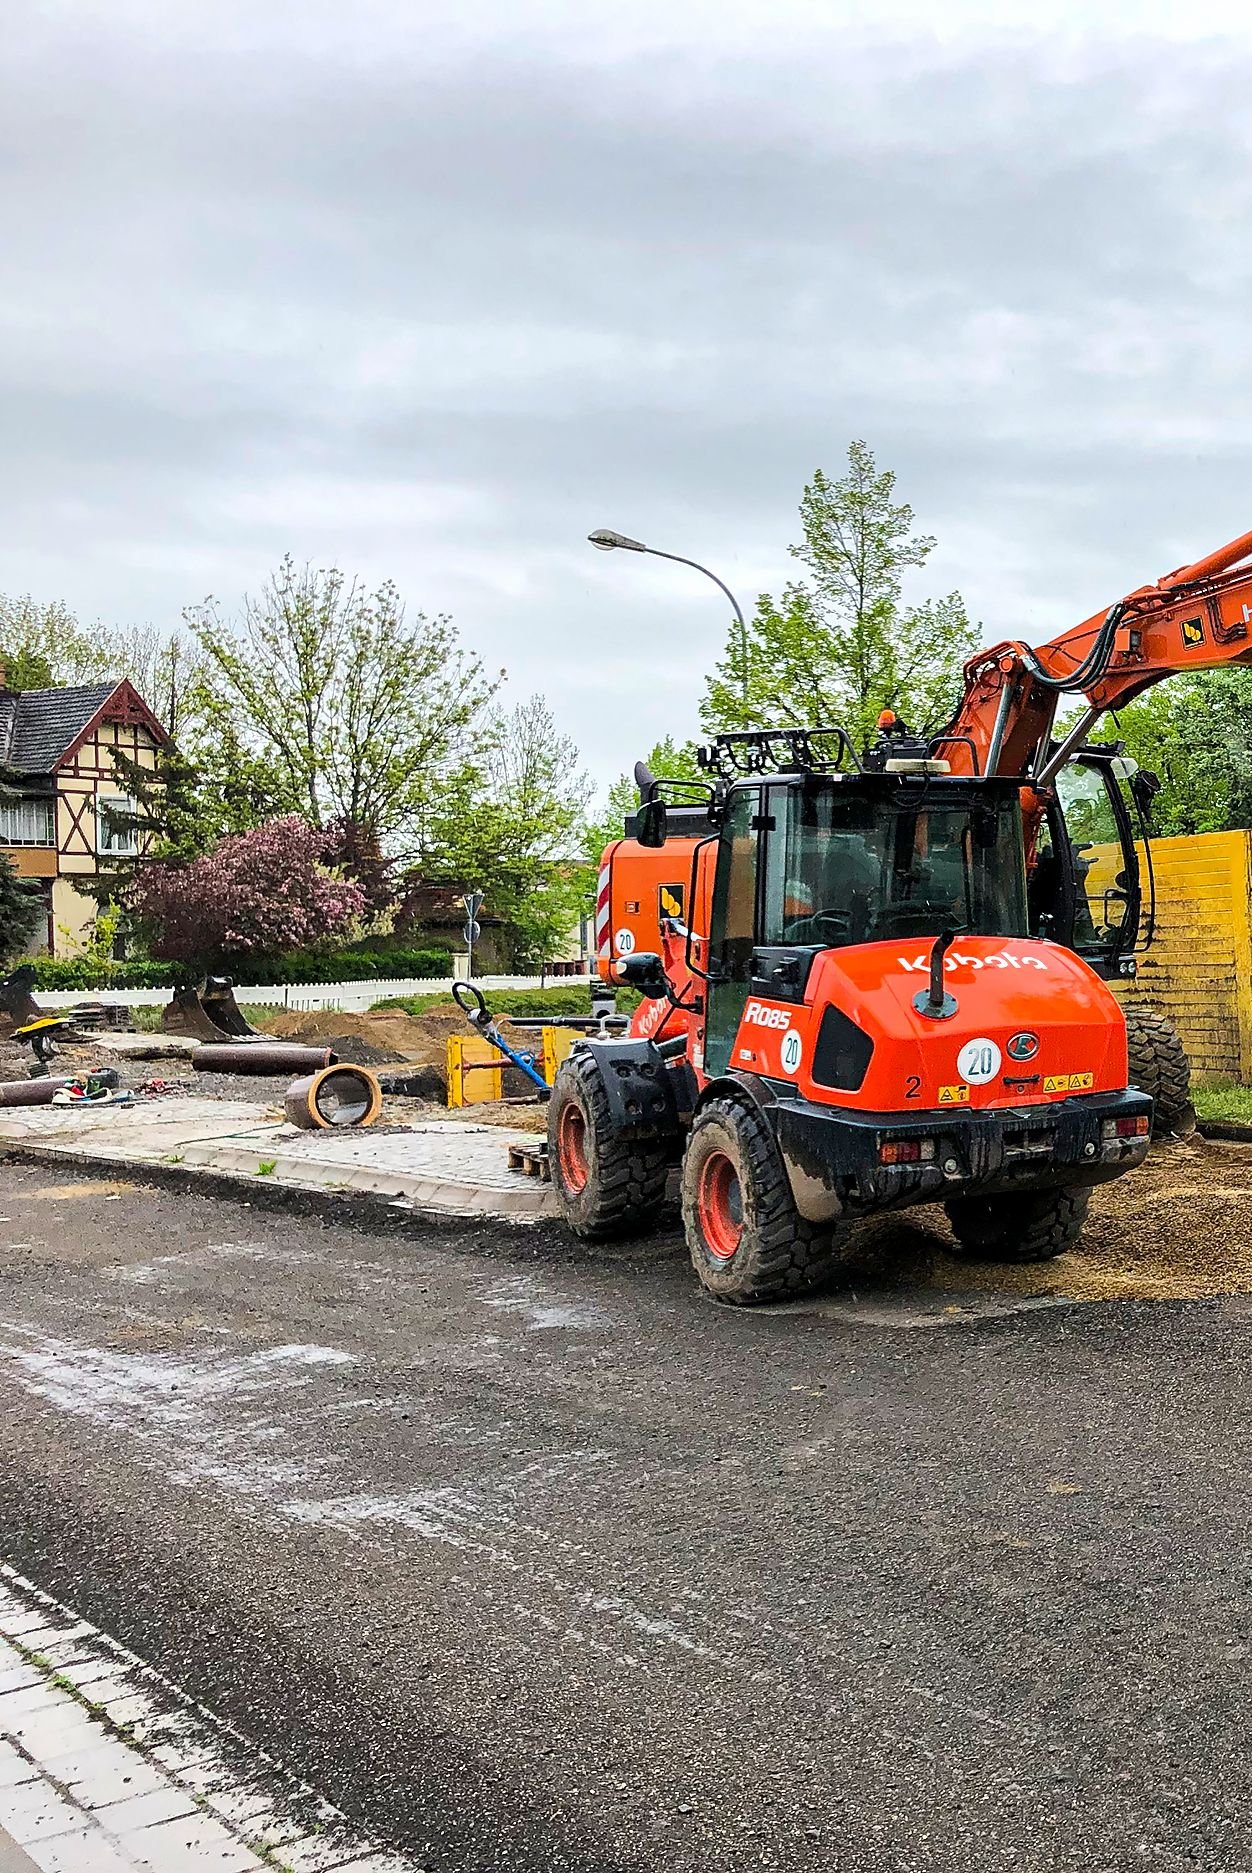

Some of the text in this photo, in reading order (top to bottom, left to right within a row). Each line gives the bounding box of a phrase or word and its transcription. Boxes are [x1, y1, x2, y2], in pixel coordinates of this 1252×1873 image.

[619, 934, 632, 950] 20
[785, 1037, 799, 1066] 20
[967, 1047, 993, 1076] 20
[904, 1076, 922, 1099] 2
